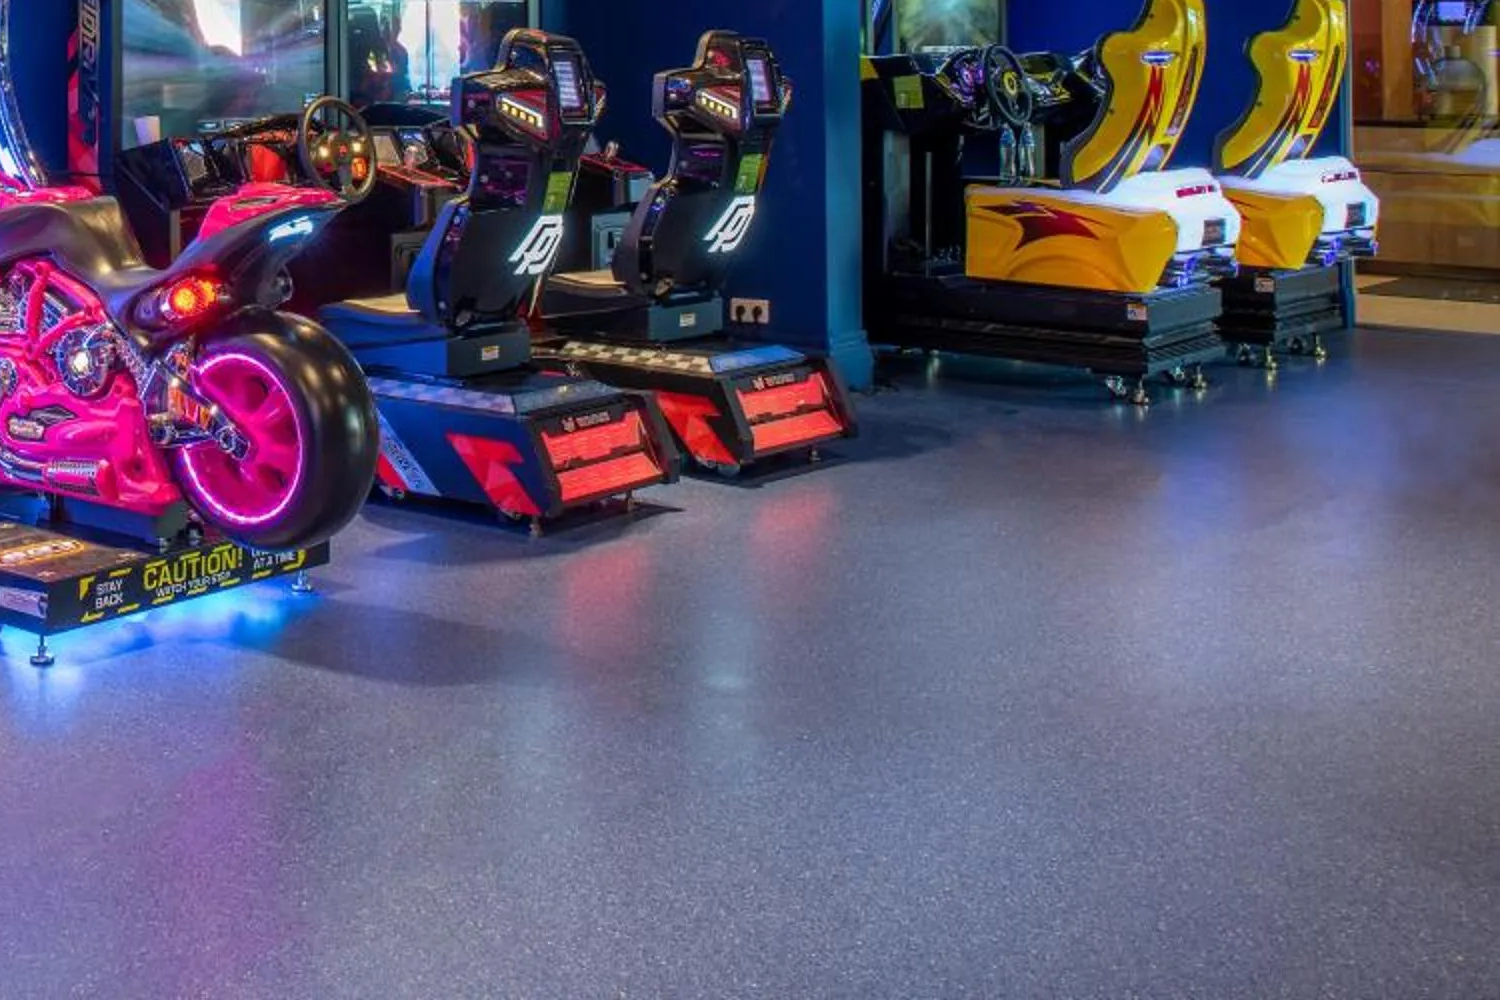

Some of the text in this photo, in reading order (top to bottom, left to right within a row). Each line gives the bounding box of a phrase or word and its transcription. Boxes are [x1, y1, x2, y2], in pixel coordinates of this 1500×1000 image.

[143, 547, 243, 590] CAUTION!
[97, 580, 123, 595] STAY
[95, 594, 124, 609] BACK
